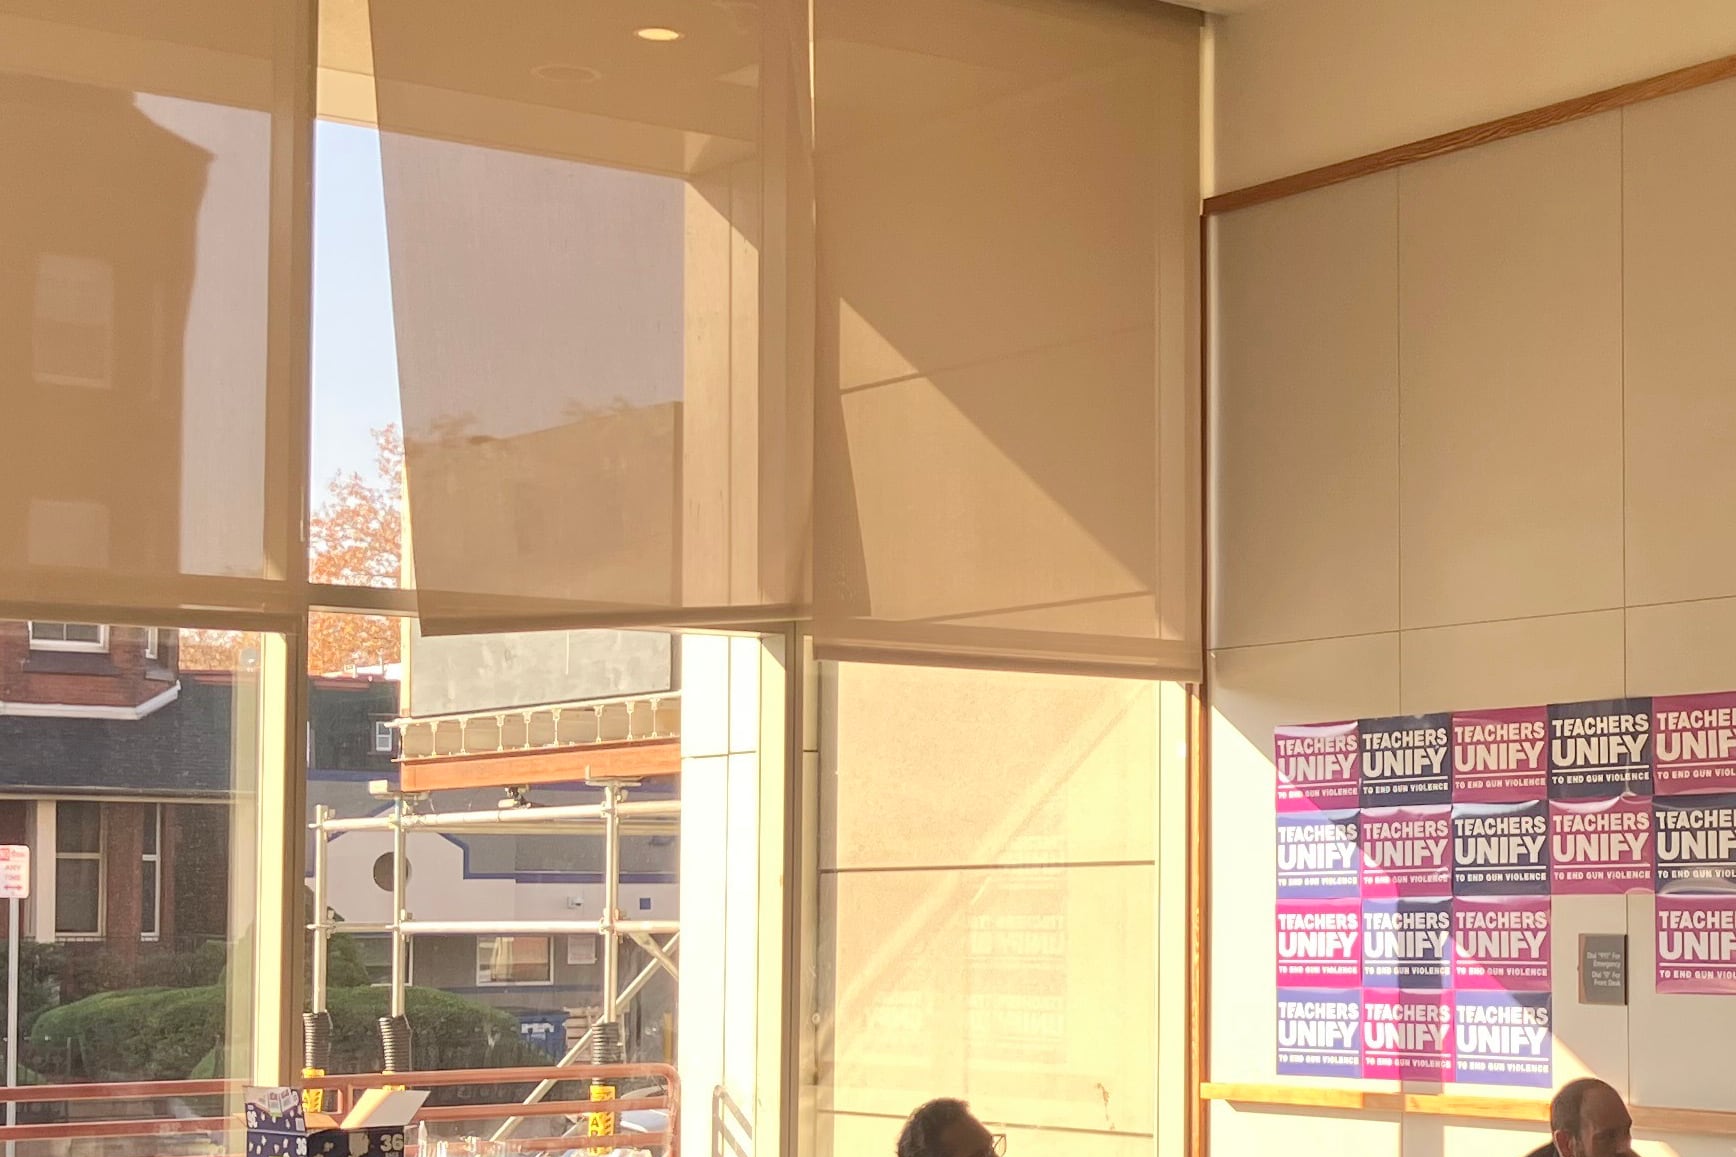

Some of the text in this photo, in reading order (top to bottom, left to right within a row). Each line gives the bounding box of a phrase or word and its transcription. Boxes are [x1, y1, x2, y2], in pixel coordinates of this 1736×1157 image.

[1455, 722, 1545, 743] TEACHERS
[1552, 714, 1649, 737] TEACHERS
[1278, 735, 1357, 755] TEACHERS
[1362, 728, 1448, 749] TEACHERS
[1455, 741, 1545, 773] UNIFY
[1552, 734, 1649, 767] UNIFY
[1278, 753, 1357, 783] UNIFY
[1363, 747, 1448, 778] UNIFY
[1456, 780, 1465, 788] TO
[1505, 777, 1545, 786] VIOLENCE
[1553, 776, 1563, 784] TO
[1606, 773, 1649, 782] VIOLENCE
[1658, 771, 1668, 779] TO
[1364, 786, 1372, 794] TO
[1410, 783, 1448, 792] VIOLENCE
[1364, 820, 1448, 839] TEACHERS
[1455, 816, 1546, 836] TEACHERS
[1553, 812, 1649, 832] TEACHERS
[1278, 824, 1357, 842] TEACHERS
[1278, 842, 1357, 870] UNIFY
[1364, 839, 1448, 868] UNIFY
[1455, 836, 1546, 865] UNIFY
[1554, 832, 1650, 863] UNIFY
[1456, 874, 1465, 882] TO
[1505, 872, 1546, 881] VIOLENCE
[1555, 871, 1564, 879] TO
[1607, 870, 1650, 879] VIOLENCE
[1659, 870, 1669, 878] TO
[1278, 913, 1357, 930] TEACHERS
[1364, 912, 1449, 929] TEACHERS
[1456, 912, 1547, 928] TEACHERS
[1279, 932, 1357, 958] UNIFY
[1364, 931, 1449, 959] UNIFY
[1456, 931, 1547, 959] UNIFY
[1661, 970, 1671, 978] TO
[1279, 1002, 1358, 1019] TEACHERS
[1365, 1004, 1450, 1021] TEACHERS
[1457, 1006, 1548, 1024] TEACHERS
[1279, 1021, 1358, 1048] UNIFY
[1365, 1023, 1450, 1052] UNIFY
[1458, 1026, 1548, 1055] UNIFY
[380, 1133, 404, 1152] 36
